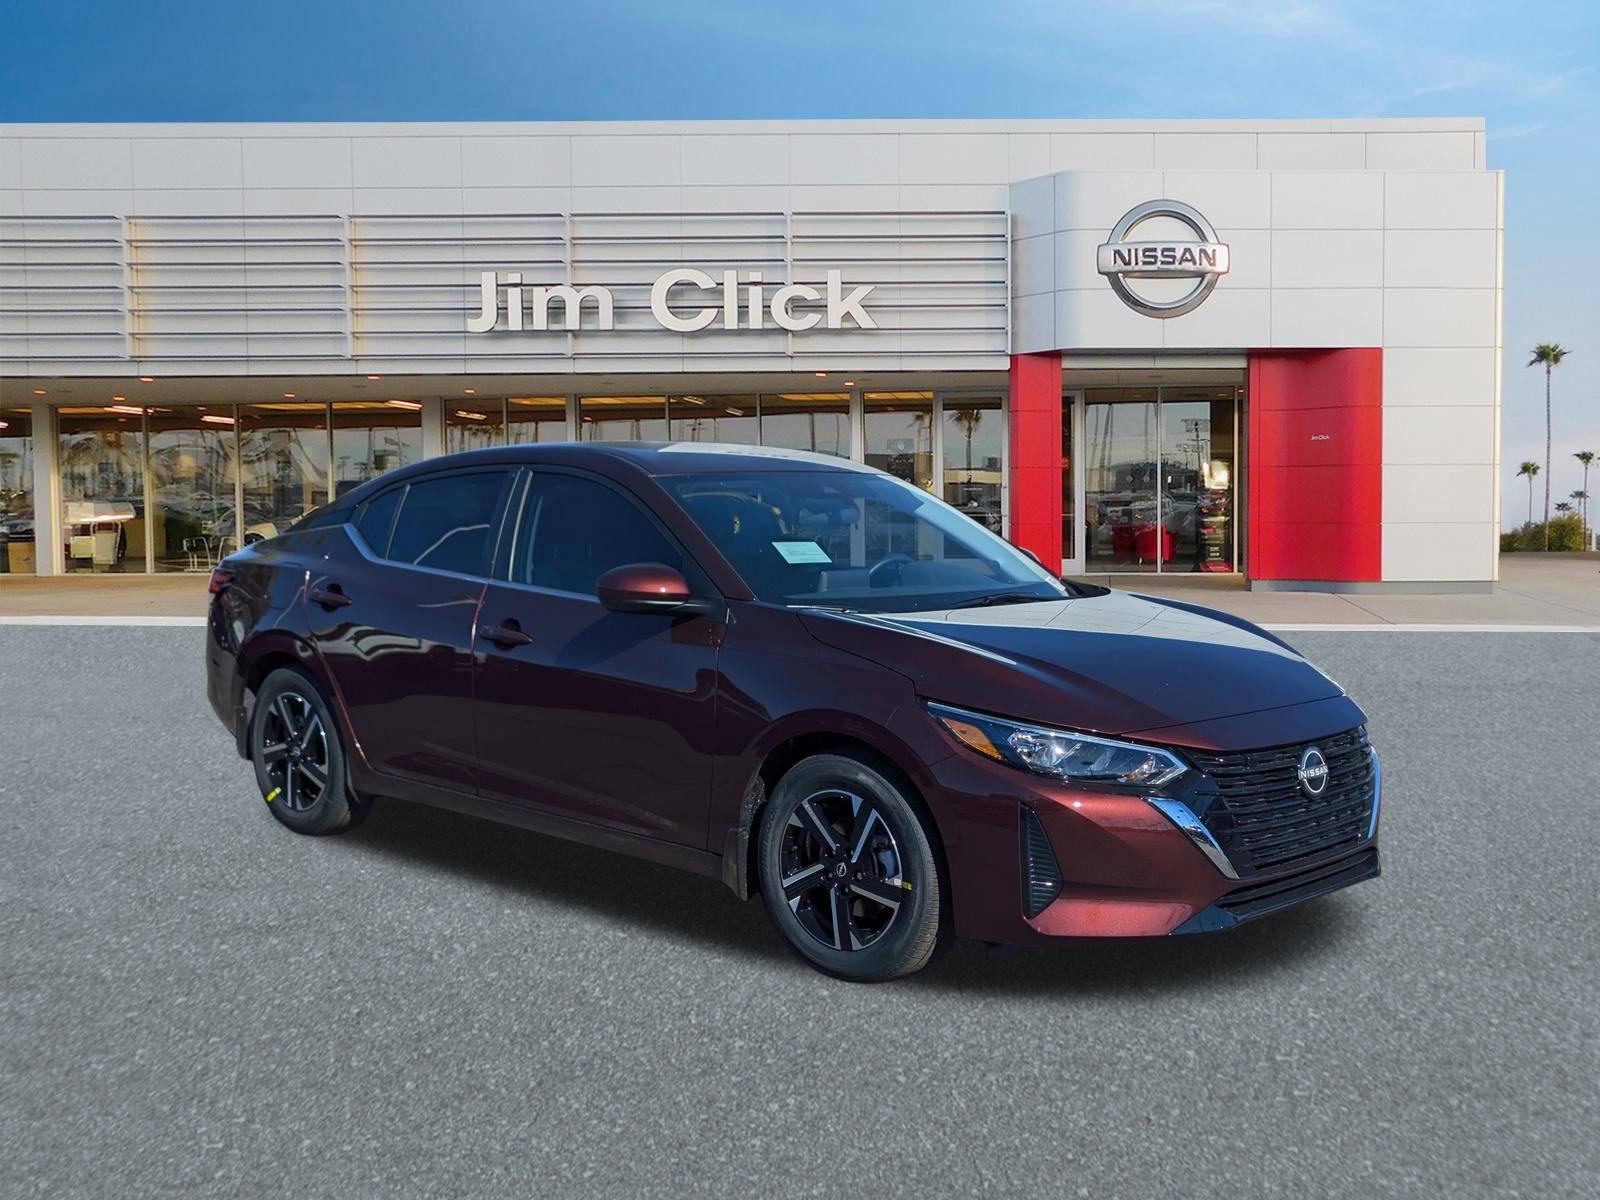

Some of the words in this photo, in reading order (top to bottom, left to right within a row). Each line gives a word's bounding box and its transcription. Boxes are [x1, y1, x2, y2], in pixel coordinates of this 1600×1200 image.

[1112, 246, 1217, 267] NISSAN
[467, 271, 614, 333] Jim
[650, 268, 879, 333] Click
[1300, 766, 1328, 779] NISSAN
